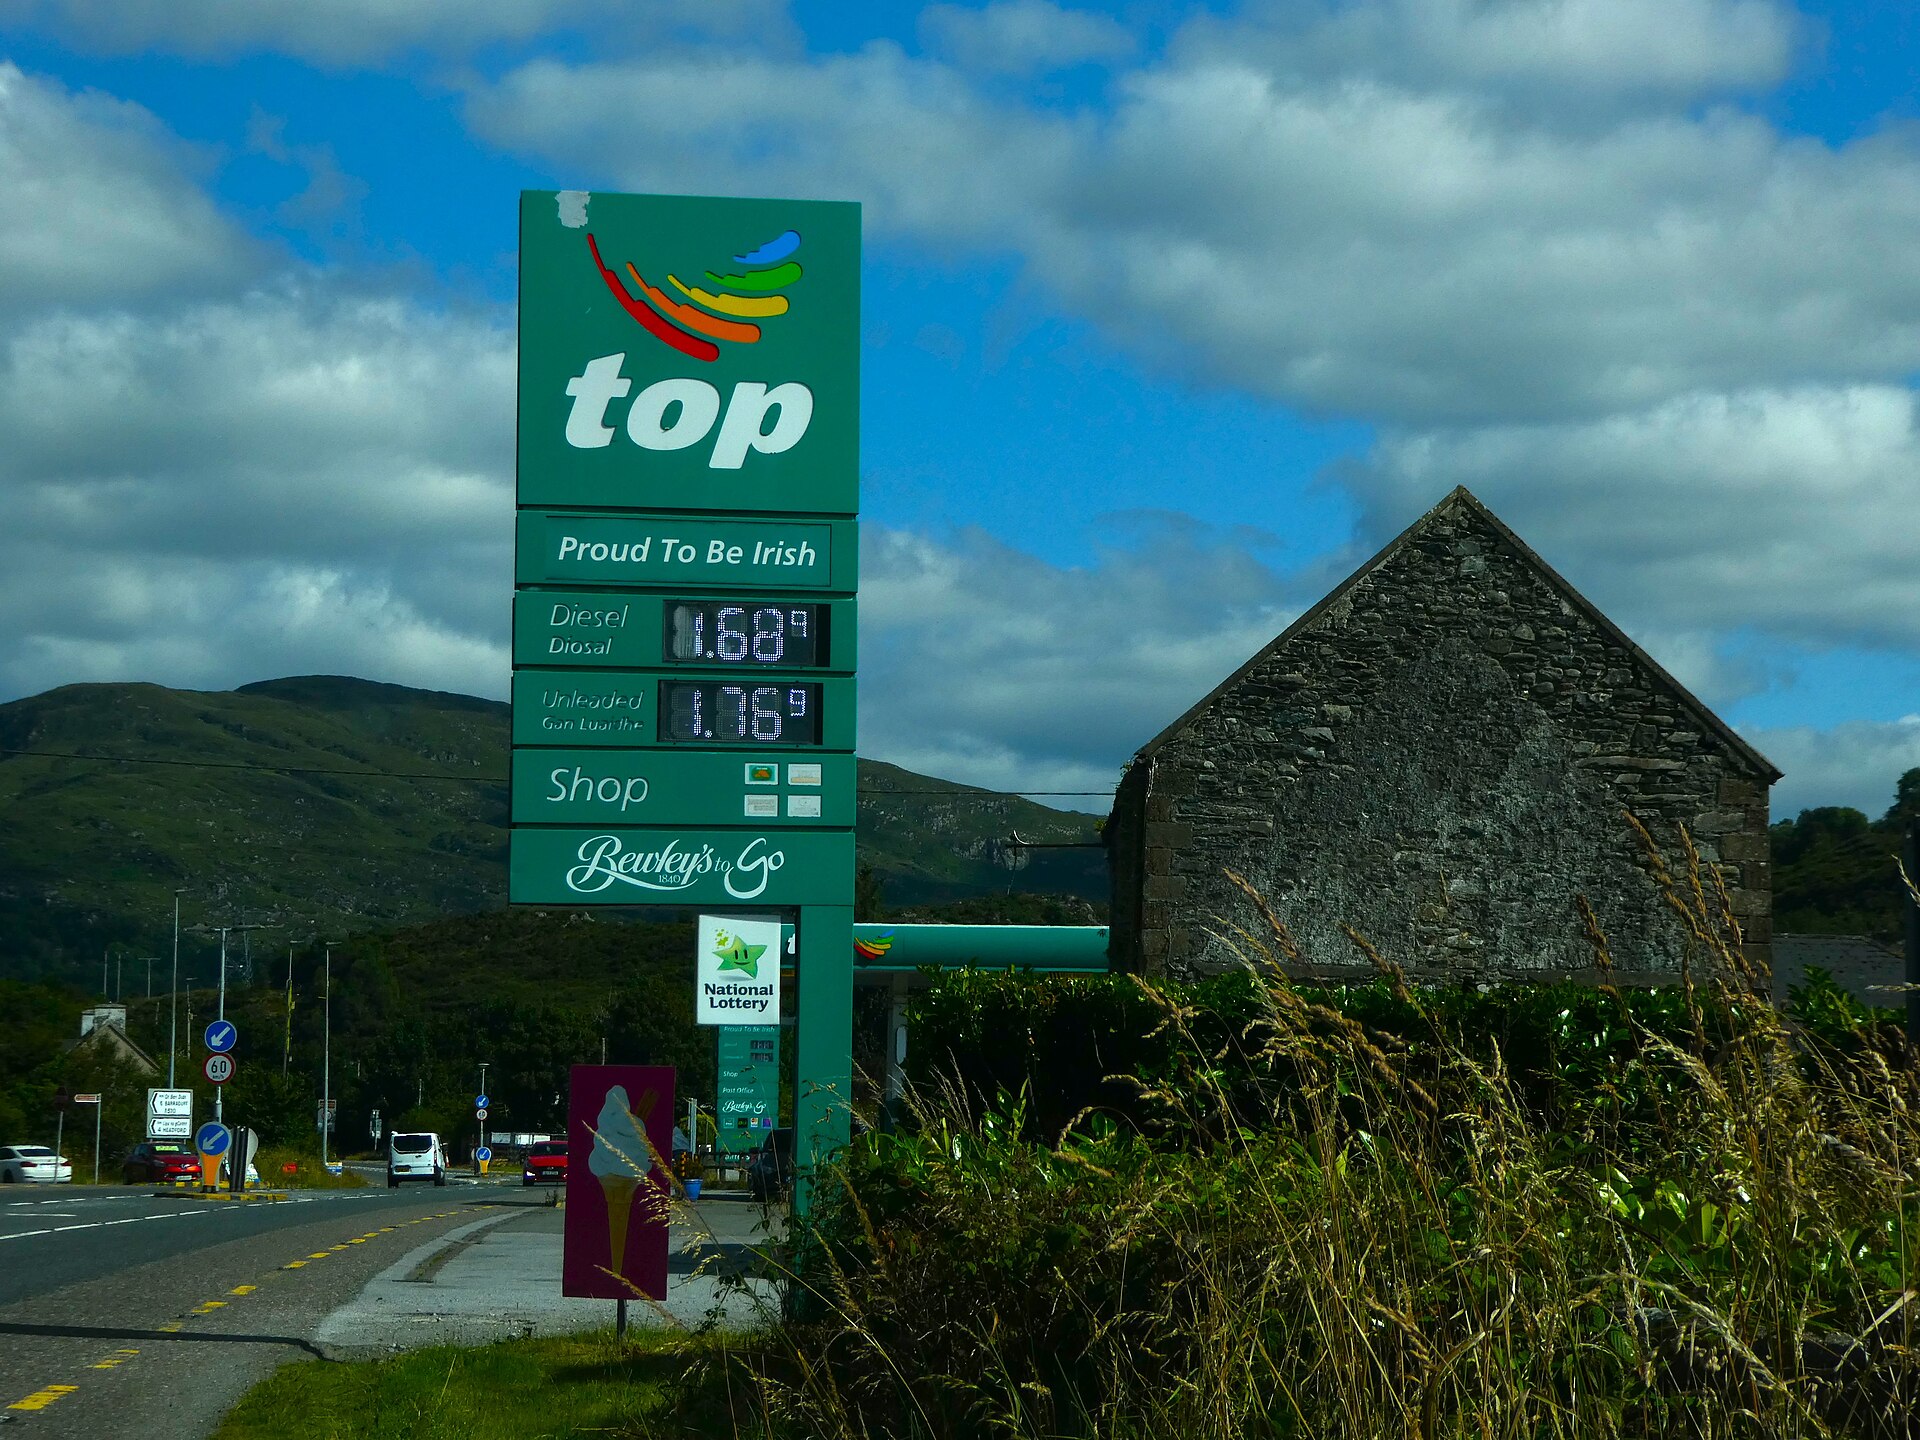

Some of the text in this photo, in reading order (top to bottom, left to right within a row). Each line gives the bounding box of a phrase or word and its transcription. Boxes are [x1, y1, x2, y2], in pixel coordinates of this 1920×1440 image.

[565, 353, 814, 470] top
[558, 537, 816, 567] Proud To Be Irish
[550, 603, 629, 628] Diesel
[548, 637, 612, 655] Diosal
[542, 689, 645, 710] Unleaded
[542, 716, 574, 730] Gan
[547, 766, 649, 812] Shop
[566, 835, 785, 900] Bewley's to Go
[658, 874, 681, 884] 1840
[704, 983, 774, 996] National
[709, 997, 769, 1013] Lottery
[211, 1060, 226, 1073] 60
[723, 1070, 739, 1078] Shop
